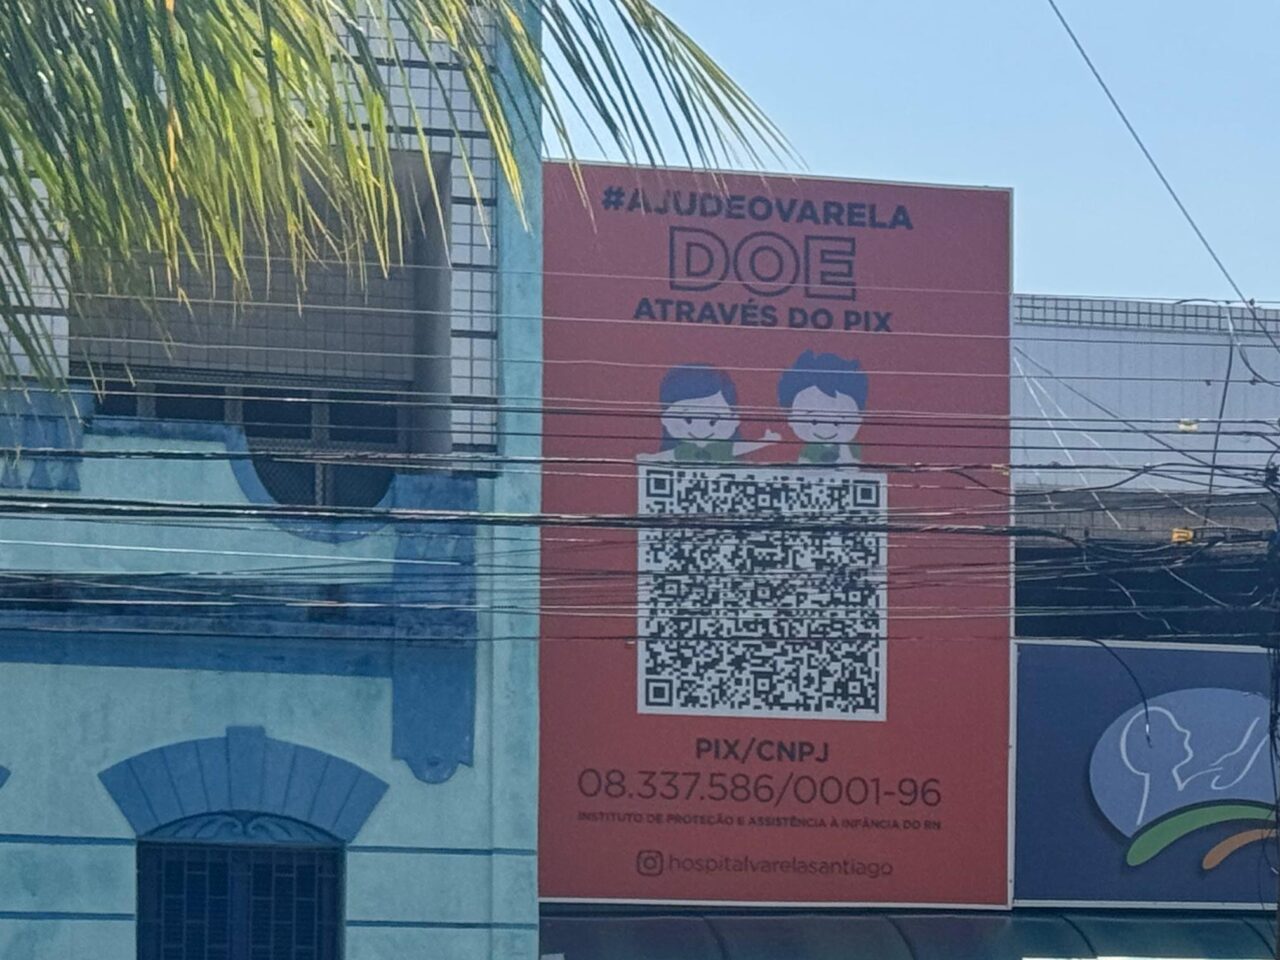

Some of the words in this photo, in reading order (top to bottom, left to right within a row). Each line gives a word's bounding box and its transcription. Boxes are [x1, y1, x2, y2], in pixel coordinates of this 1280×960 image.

[601, 185, 914, 231] #AJUDEOVARELA
[669, 225, 857, 302] DOE
[633, 298, 778, 328] ATRAVÉS
[788, 306, 834, 331] DO
[843, 310, 893, 334] PIX
[695, 737, 830, 763] PIX/CNPJ
[577, 767, 943, 808] 08.337.586/0001-96
[577, 810, 643, 824] INSTITUTO
[646, 812, 664, 825] DE
[737, 815, 745, 826] E
[748, 814, 827, 829] ASSISTÊNCIA
[903, 818, 920, 830] DO
[923, 819, 942, 831] RN
[667, 853, 894, 879] hospitalvarelasantiago
